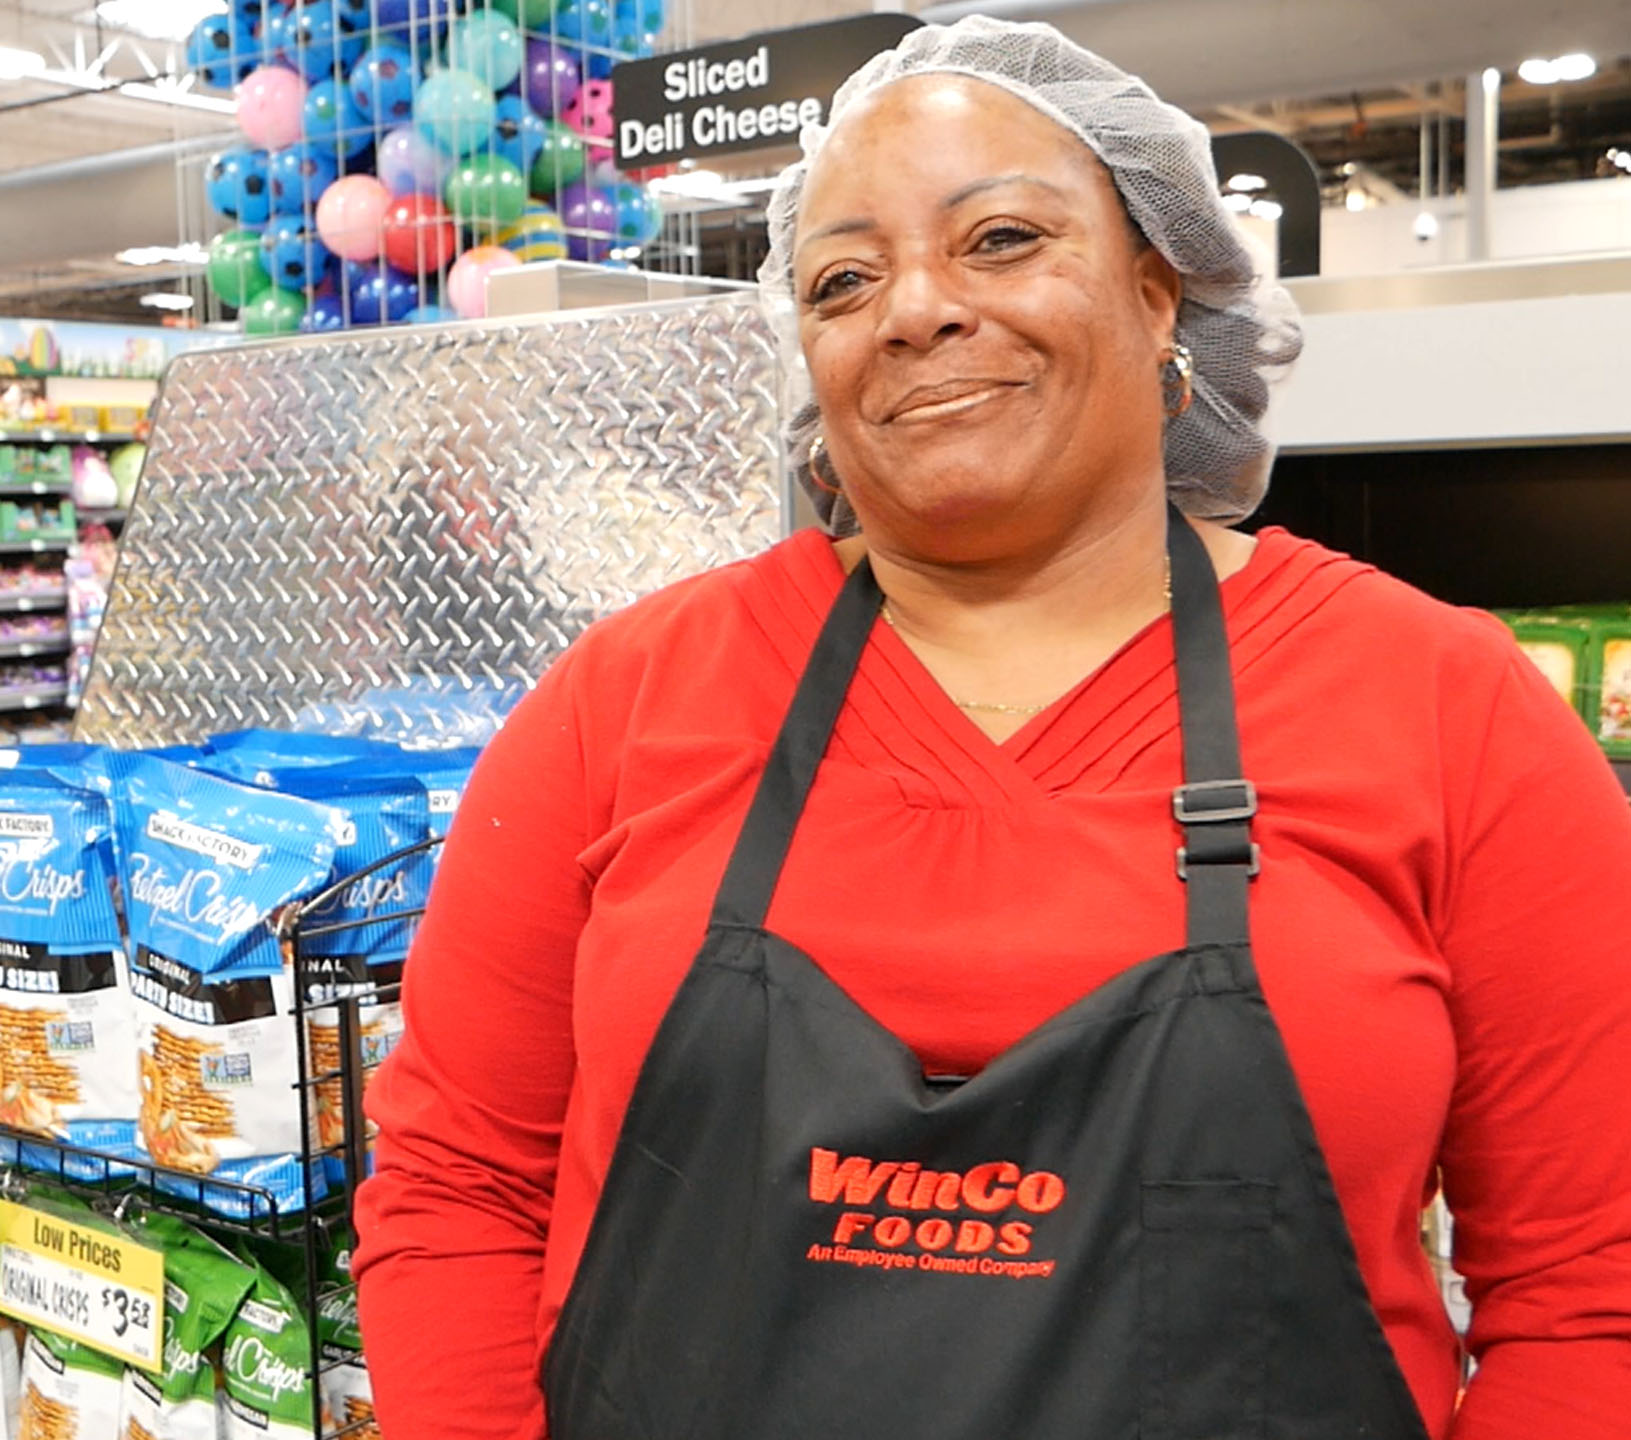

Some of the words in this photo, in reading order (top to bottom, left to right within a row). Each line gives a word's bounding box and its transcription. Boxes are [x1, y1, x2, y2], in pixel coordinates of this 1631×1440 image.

[664, 46, 769, 102] Sliced
[620, 111, 684, 158] Deli
[692, 97, 822, 146] Cheese
[1, 848, 85, 917] Crisps
[130, 852, 194, 928] Pretzel
[149, 953, 190, 985] ORIGINAL
[809, 1146, 1066, 1213] WinCo
[33, 1216, 64, 1253] Low
[68, 1229, 123, 1273] Prices
[807, 1243, 833, 1261] An
[833, 1244, 916, 1269] Employee
[918, 1253, 978, 1274] Owned
[978, 1256, 1056, 1278] Company
[833, 1212, 1034, 1255] FOODS
[2, 1262, 49, 1311] ORIGINAL
[52, 1281, 90, 1327] CRISPS
[237, 1336, 305, 1402] Crisps
